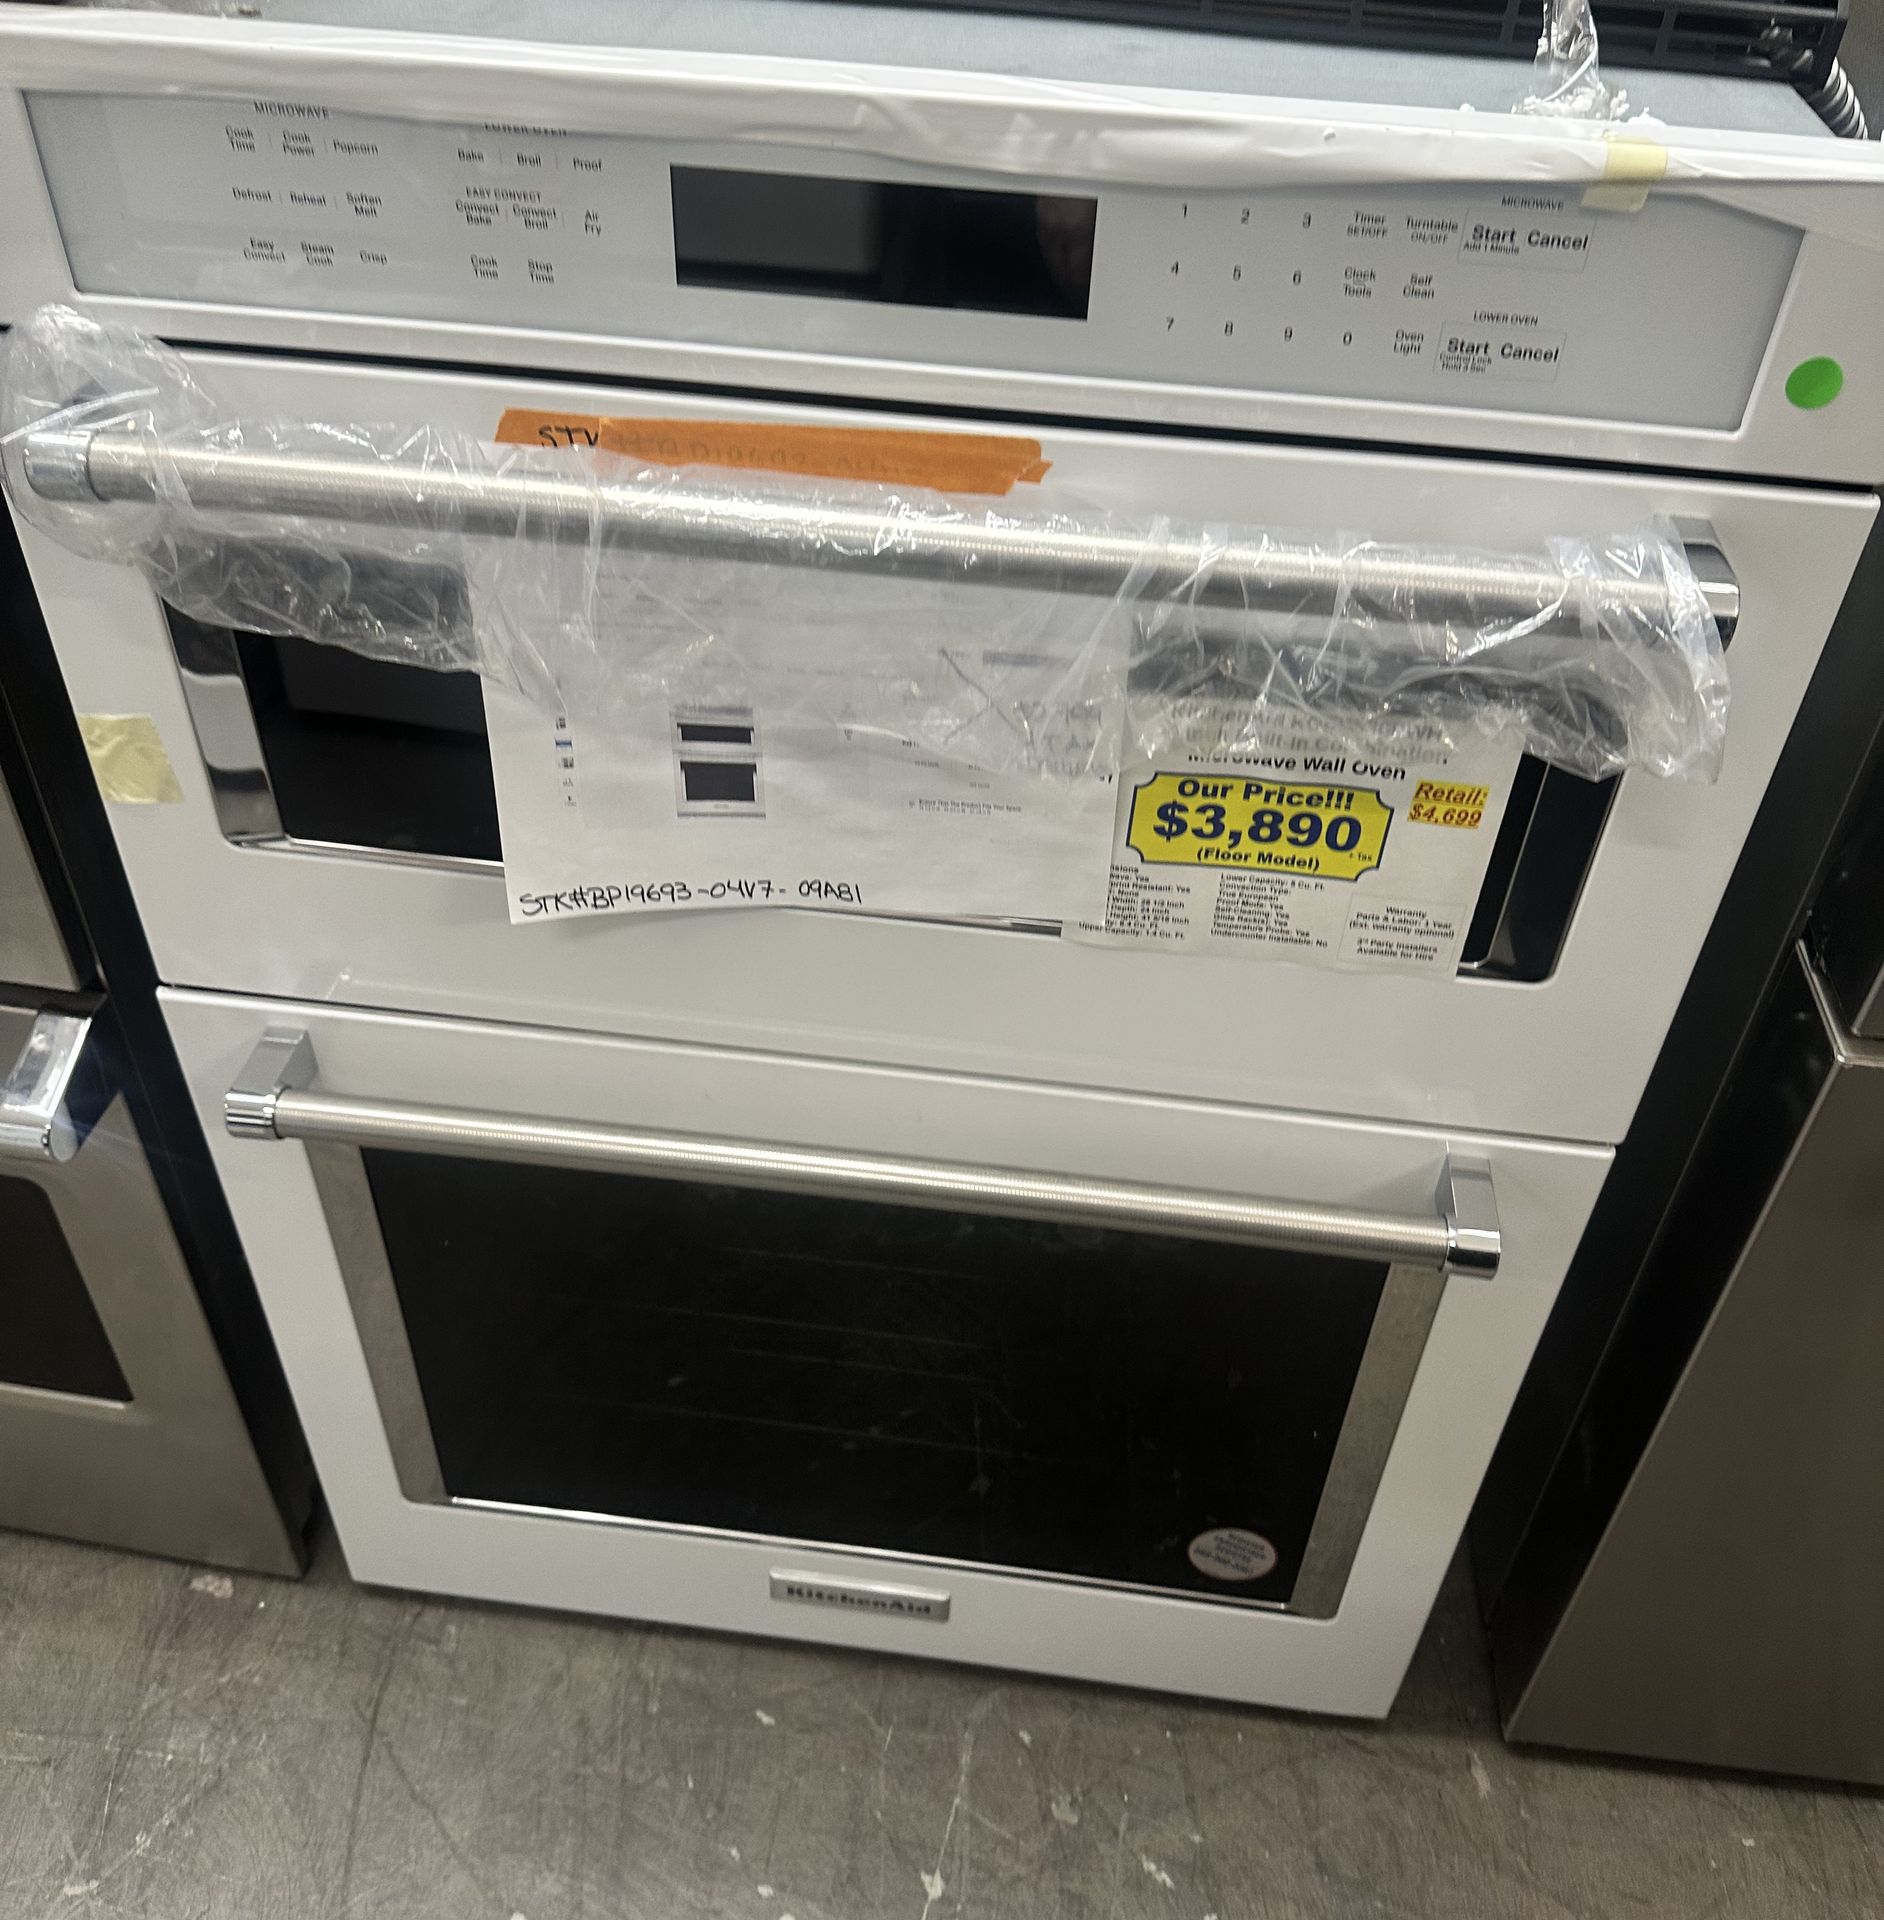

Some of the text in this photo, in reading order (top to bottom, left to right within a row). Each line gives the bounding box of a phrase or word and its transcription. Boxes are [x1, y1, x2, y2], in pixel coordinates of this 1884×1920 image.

[253, 100, 330, 119] MICROWAVE
[225, 125, 254, 141] Cook
[282, 129, 311, 144] Cook
[230, 139, 256, 152] Time
[283, 143, 315, 157] Power
[332, 138, 379, 156] Popcorn
[457, 148, 484, 162] Bake
[516, 152, 542, 168] Broil
[572, 157, 602, 171] Proof
[232, 187, 272, 203] Defrost
[289, 191, 327, 207] Reheat
[346, 191, 382, 206] Soften
[466, 186, 541, 203] EASY CONVECT
[354, 204, 378, 218] Melt
[456, 199, 499, 216] Convect
[513, 203, 556, 220] Convect
[1501, 195, 1564, 212] MICROWAVE
[466, 213, 492, 227] Bake
[585, 208, 599, 223] Air
[1241, 208, 1250, 224] 2
[1302, 211, 1312, 229] 3
[1354, 211, 1385, 227] Timer
[524, 218, 549, 231] Broil
[584, 222, 602, 237] Fry
[1347, 225, 1388, 239] SET/OFF
[1406, 215, 1459, 233] Turntable
[250, 237, 275, 253] Easy
[1411, 231, 1448, 245] ON/OFF
[1472, 223, 1589, 251] Start Cancel
[243, 248, 286, 264] Convect
[300, 241, 335, 256] Steam
[305, 254, 334, 267] Cook
[360, 250, 387, 266] Crisp
[470, 254, 498, 269] Cook
[528, 258, 553, 274] Stop
[473, 267, 499, 281] Time
[530, 273, 555, 285] Time
[1171, 260, 1301, 286] 4 5 6
[1344, 266, 1376, 282] Clock
[1410, 272, 1433, 287] Self
[1344, 283, 1372, 298] Tools
[1403, 284, 1435, 299] Clean
[1473, 310, 1539, 327] LOWER OVEN
[1166, 316, 1352, 346] 7 8 9 0
[1395, 329, 1424, 343] Oven
[1393, 341, 1421, 356] Light
[1447, 337, 1560, 364] Start Cancel
[1303, 756, 1345, 774] Wall
[1352, 759, 1406, 782] Oven
[1177, 778, 1355, 811] Our Price!!!
[1413, 782, 1488, 806] Retail:
[1152, 801, 1362, 851] $3,890
[1196, 847, 1320, 872] (Floor Model)
[1221, 871, 1247, 882] Lower
[1356, 911, 1380, 921] Parts
[1432, 919, 1453, 930] Year
[1385, 906, 1428, 919] Warranty
[1370, 938, 1394, 949] Party
[787, 1586, 932, 1614] KitchenAid
